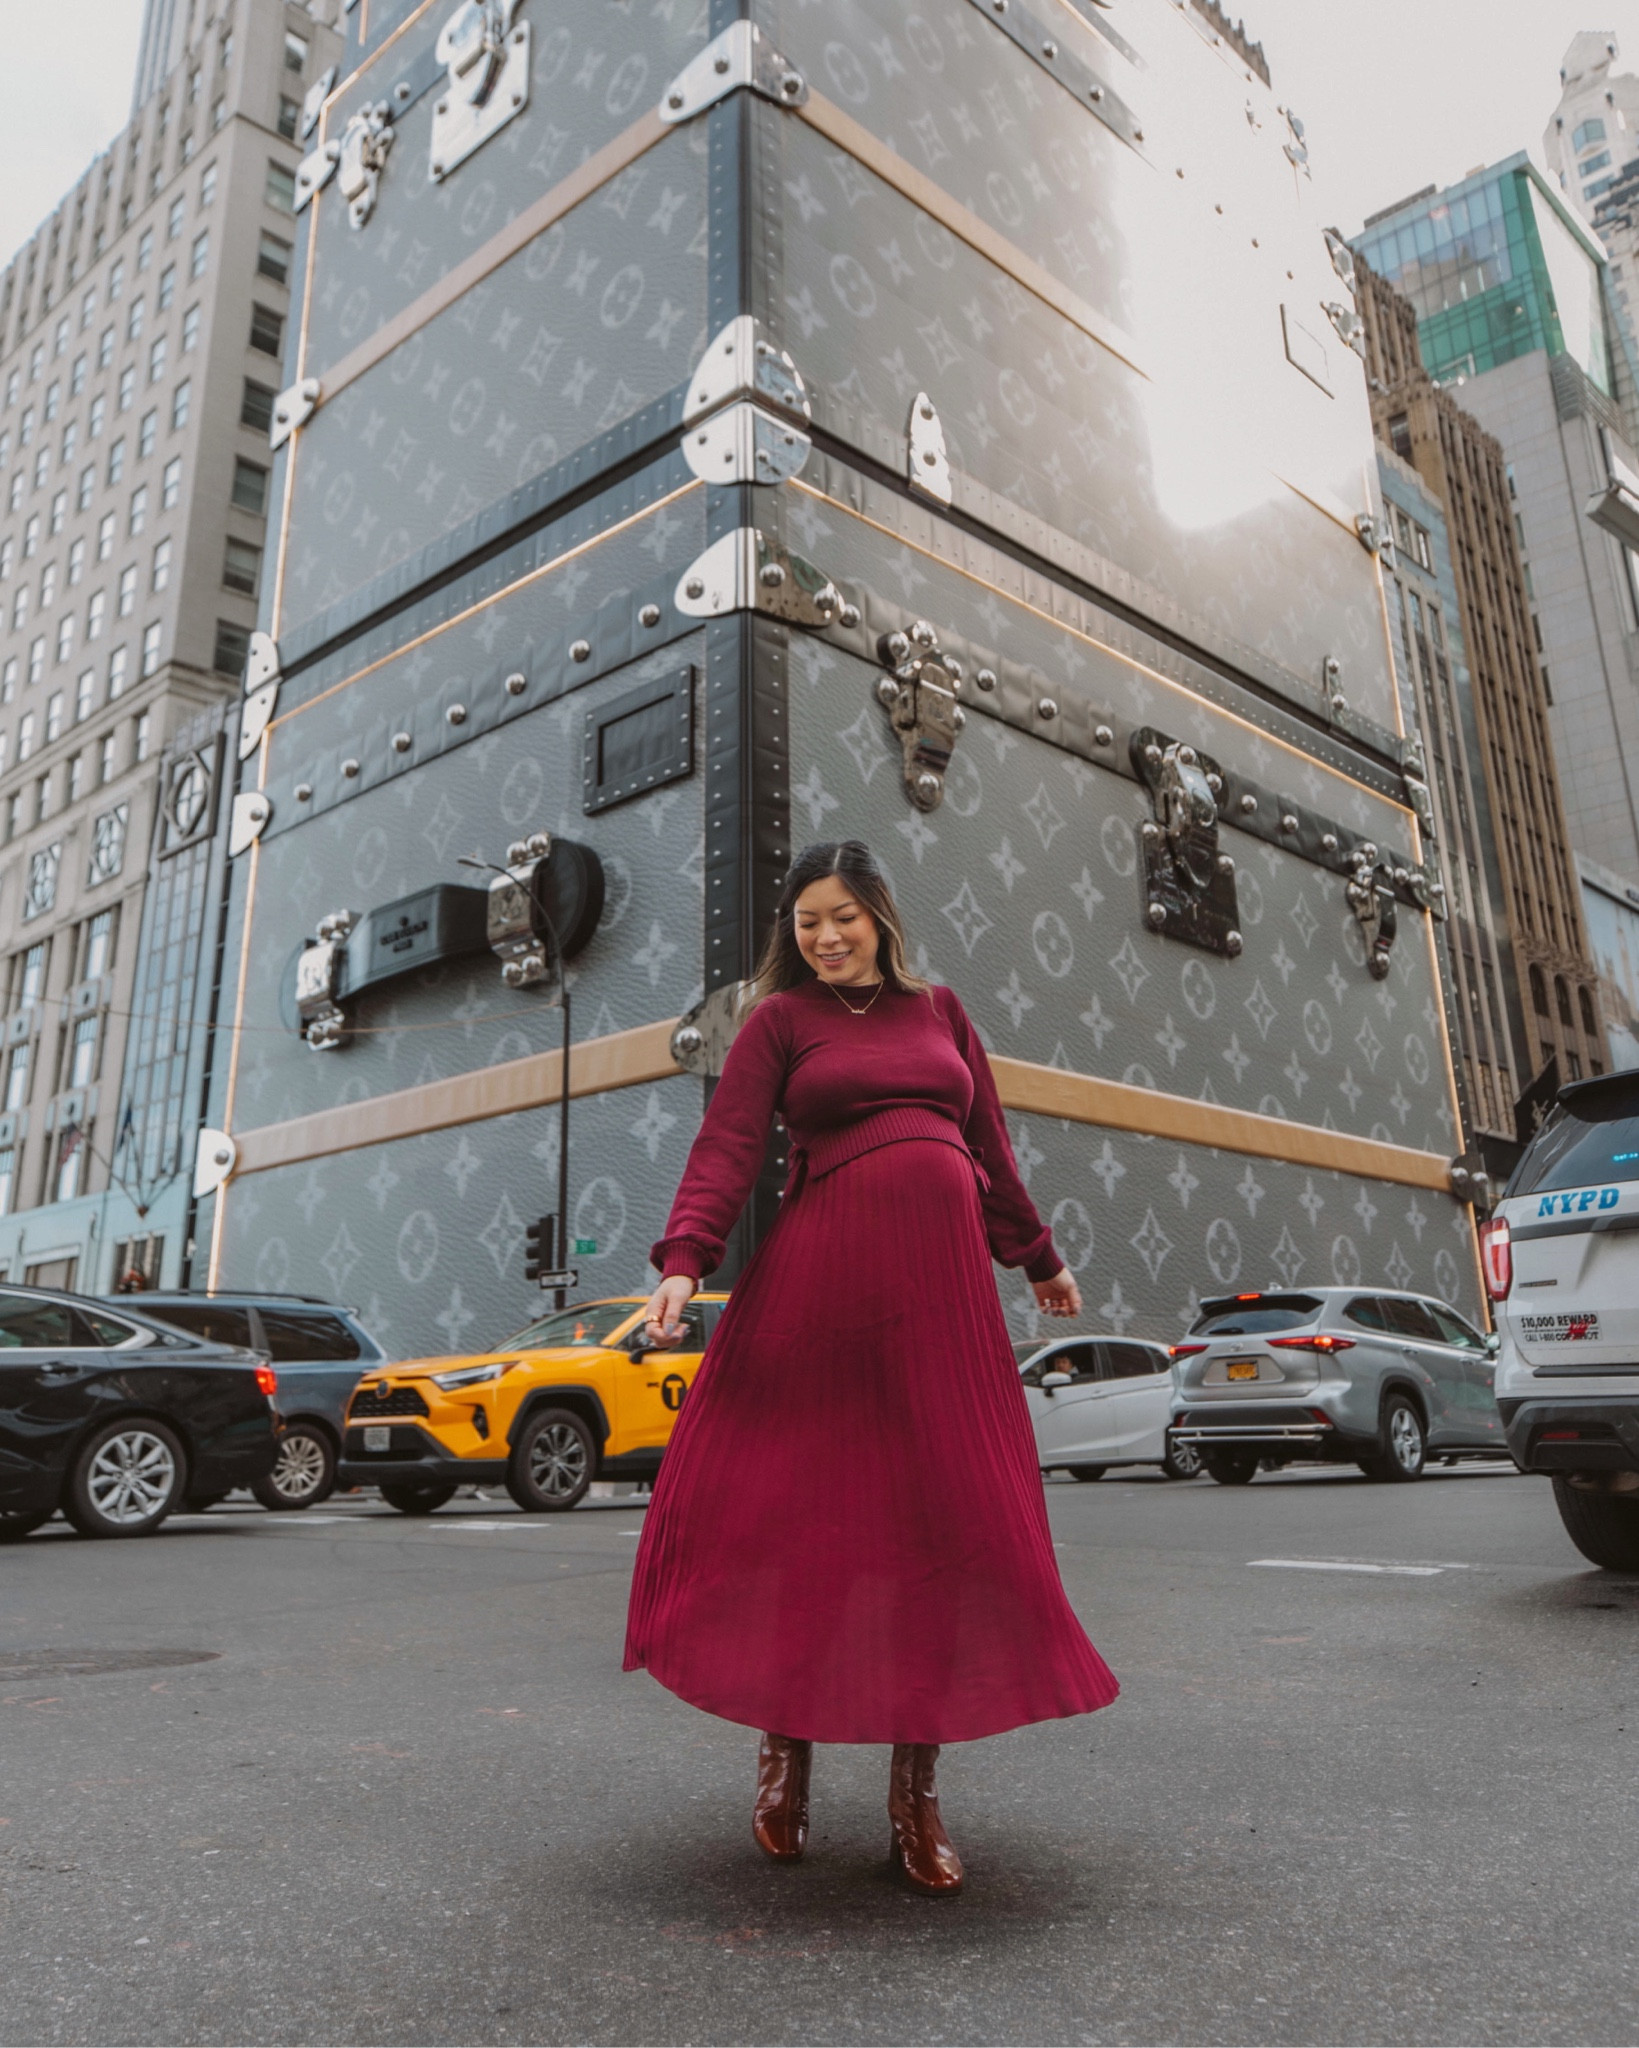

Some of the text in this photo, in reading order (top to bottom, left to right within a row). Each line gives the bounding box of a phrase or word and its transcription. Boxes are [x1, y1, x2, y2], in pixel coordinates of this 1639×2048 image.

[1537, 1188, 1620, 1217] NYPD
[1521, 1315, 1555, 1330] $10,000
[1557, 1313, 1598, 1327] REWARD
[1525, 1333, 1538, 1342] CALL
[665, 1380, 683, 1408] T
